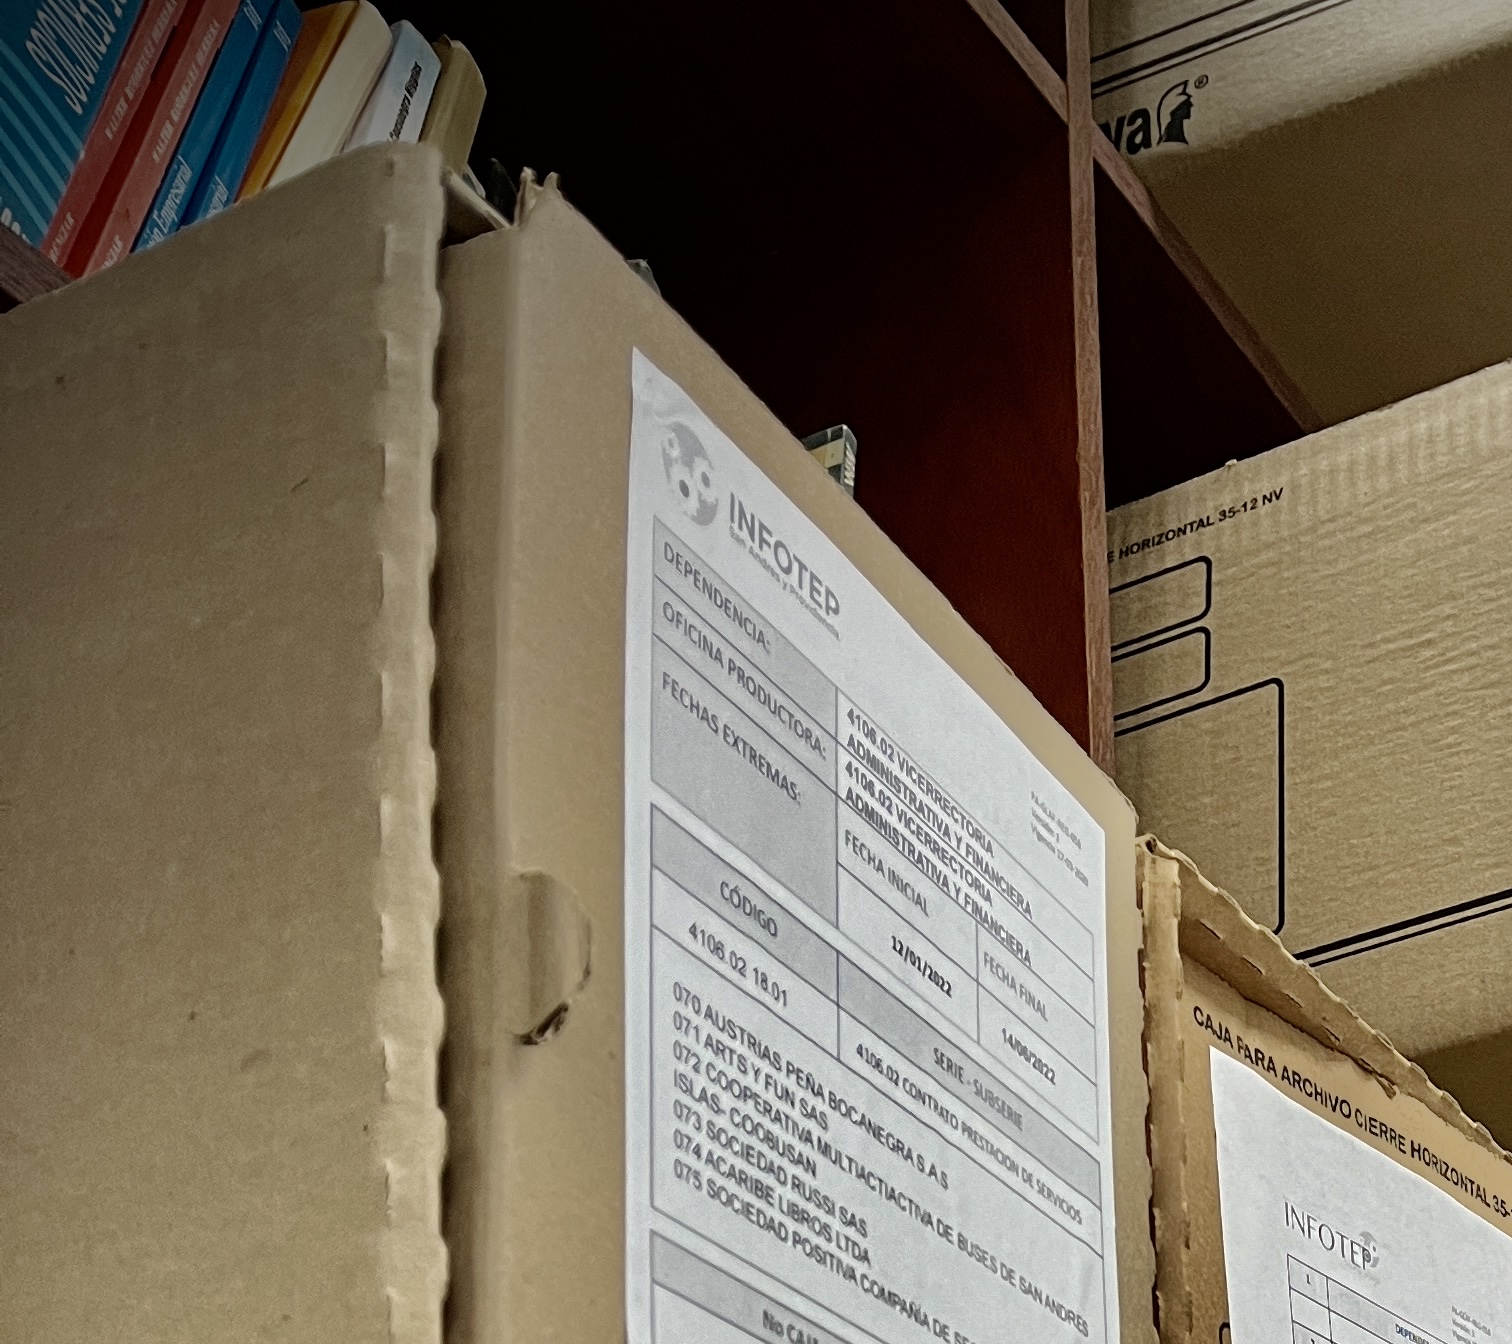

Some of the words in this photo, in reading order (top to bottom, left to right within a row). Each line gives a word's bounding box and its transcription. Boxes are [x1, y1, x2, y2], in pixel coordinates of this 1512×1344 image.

[730, 492, 840, 616] INFOTEP
[1119, 516, 1215, 561] HORIZONTAL
[1218, 498, 1257, 525] 35-12
[1262, 488, 1284, 506] NV
[664, 541, 770, 654] DEPENDENCIA:
[662, 601, 723, 668] OFICINA
[727, 656, 826, 761] PRODUCTORA:
[662, 671, 718, 733] FECHAS
[723, 723, 801, 805] EXTREMAS:
[845, 760, 893, 815] 4106.02
[895, 800, 992, 906] VICERRECTORIA
[846, 708, 894, 763] 4106.02
[896, 750, 994, 857] VICERRECTORIA
[847, 733, 950, 839] ADMINISTRATIVA
[953, 827, 963, 847] Y
[966, 837, 1033, 919] FINANCIERA
[720, 880, 778, 938] CÓDIGO
[844, 829, 885, 878] FECHA
[888, 870, 929, 916] INICIAL
[845, 787, 949, 892] ADMINISTRATIVA
[953, 883, 962, 902] Y
[964, 893, 1032, 967] FINANCIERA
[689, 922, 747, 978] 4106.02
[752, 966, 788, 1007] 18.01
[891, 935, 952, 998] 12/01/2022
[983, 952, 1017, 993] FECHA
[1019, 986, 1048, 1021] FINAL
[673, 1011, 700, 1043] 071
[704, 1034, 747, 1073] ARTS
[752, 1063, 761, 1082] Y
[764, 1072, 797, 1109] FUN
[800, 1099, 828, 1132] SAS
[673, 981, 701, 1016] 070
[704, 1004, 782, 1070] AUSTRIAS
[785, 1059, 824, 1098] PEÑA
[828, 1090, 915, 1166] BOCANEGRA
[933, 1047, 964, 1084] SERIE
[973, 1079, 1024, 1131] SUBSERIE
[1193, 1006, 1233, 1049] CAJA
[1237, 1035, 1277, 1078] PARA
[1281, 1065, 1352, 1119] ARCHIVO
[1355, 1108, 1406, 1154] CIERRE
[1411, 1140, 1491, 1208] HORIZONTAL
[673, 1099, 701, 1131] 073
[705, 1122, 787, 1186] SOCIEDAD
[791, 1176, 836, 1218] RUSSI
[839, 1207, 868, 1239] SAS
[673, 1040, 701, 1073] 072
[705, 1062, 814, 1149] COOPERATIVA
[937, 1219, 953, 1243] DE
[958, 1233, 998, 1275] BUSES
[1001, 1265, 1016, 1288] DE
[1019, 1277, 1043, 1307] SAN
[1045, 1291, 1089, 1338] ANDRES
[730, 1106, 816, 1178] COOBUSAN
[903, 1078, 959, 1131] CONTRATO
[1021, 1169, 1034, 1191] DE
[673, 1129, 701, 1161] 074
[704, 1151, 775, 1205] ACARIBE
[778, 1196, 832, 1243] LIBROS
[835, 1232, 871, 1267] LTDA
[673, 1159, 702, 1191] 075
[706, 1175, 788, 1244] SOCIEDAD
[792, 1235, 857, 1284] POSITIVA
[933, 1319, 951, 1344] DE
[1285, 1201, 1372, 1270] INFOTEP
[763, 1310, 783, 1338] No
